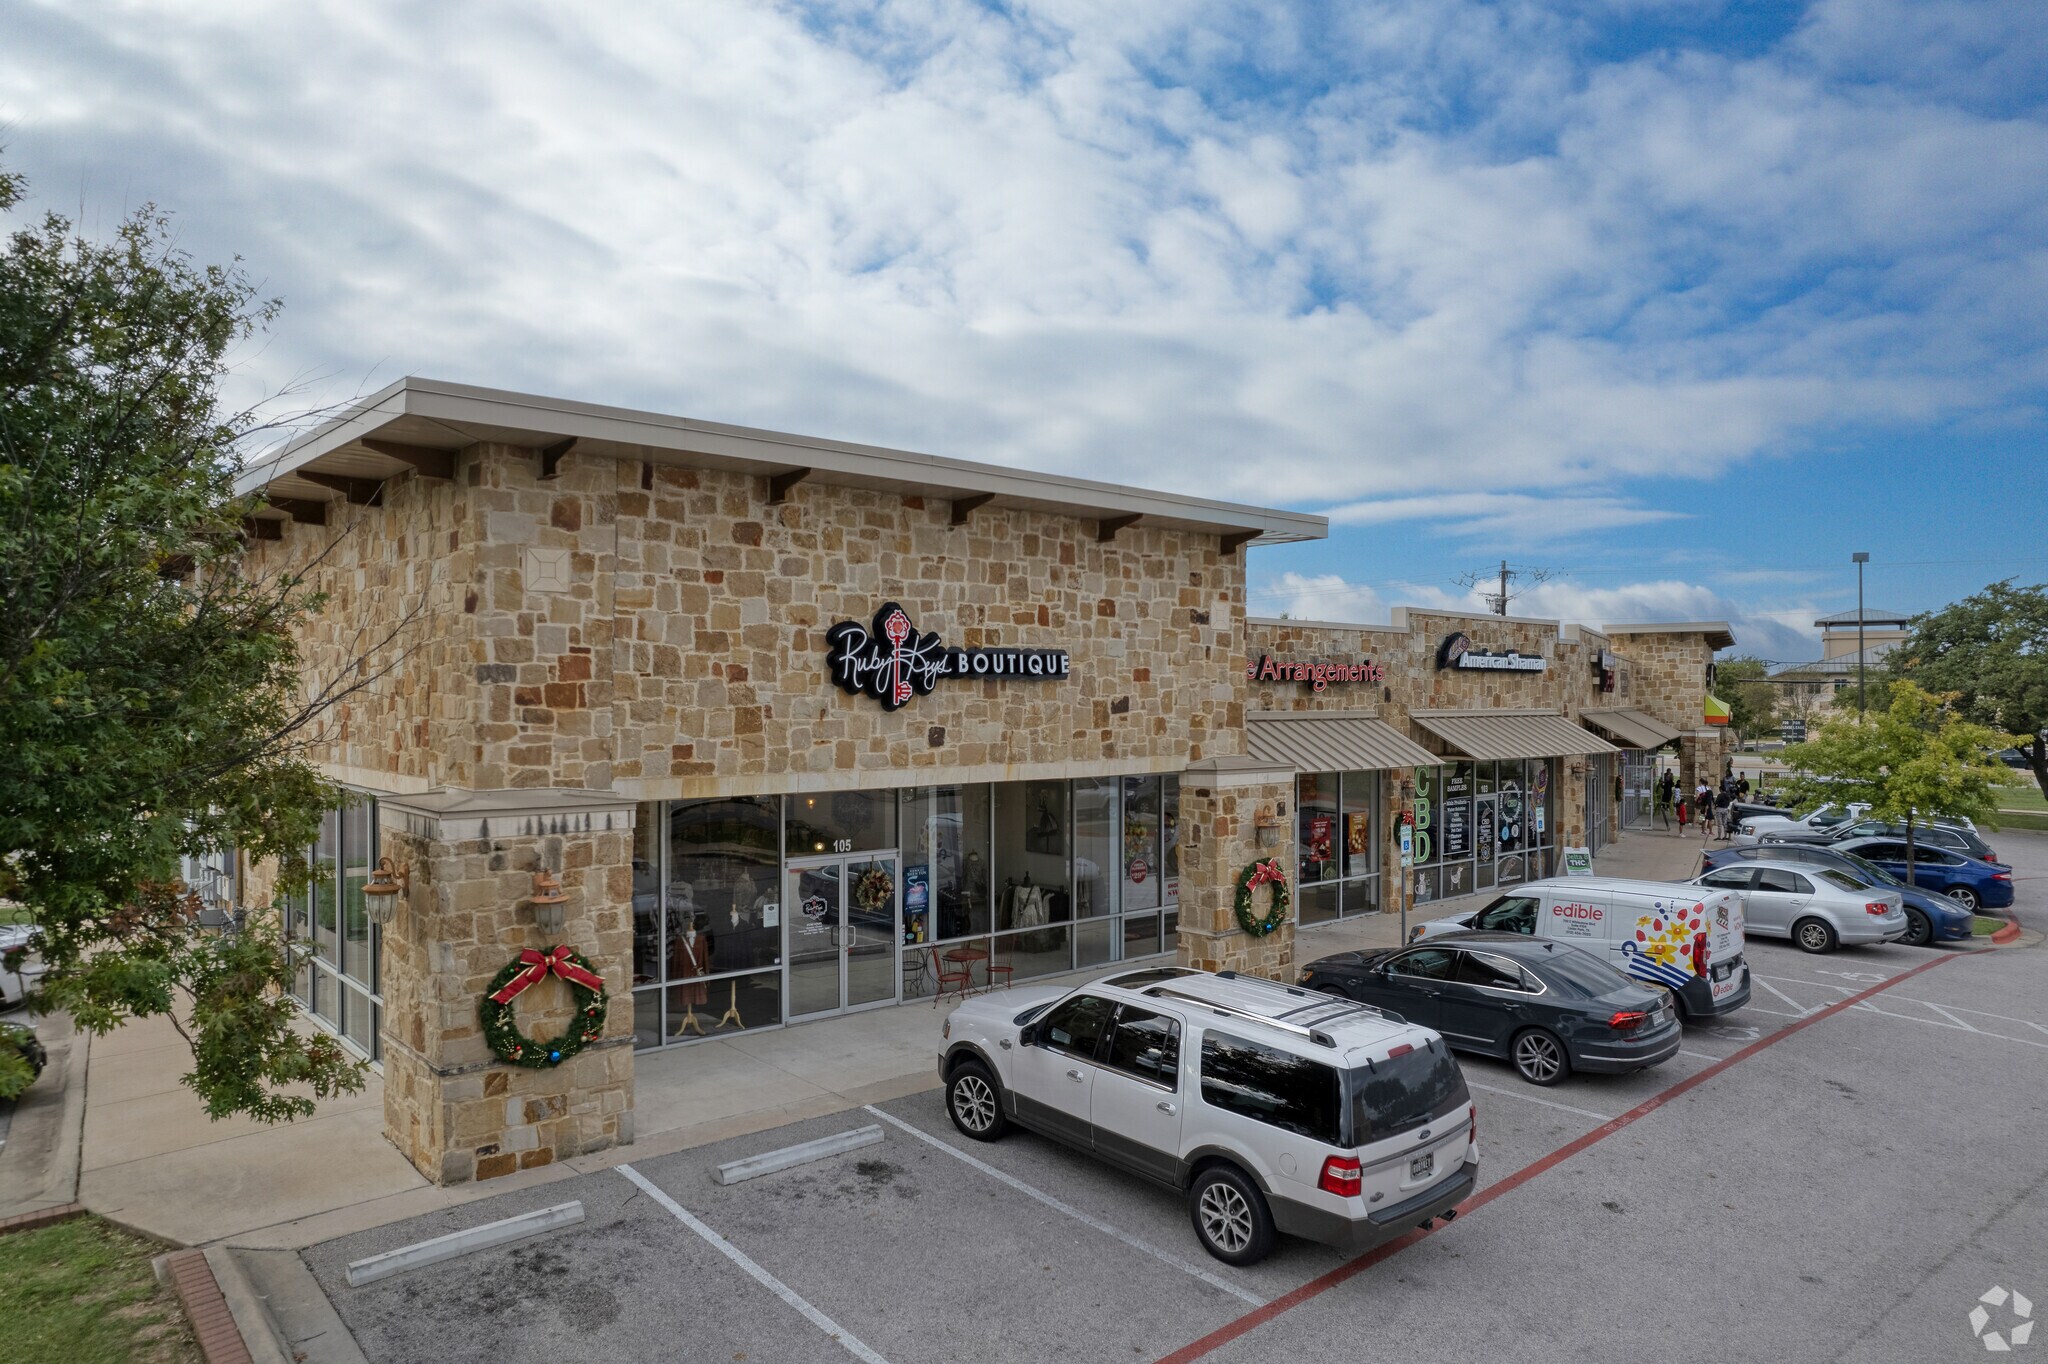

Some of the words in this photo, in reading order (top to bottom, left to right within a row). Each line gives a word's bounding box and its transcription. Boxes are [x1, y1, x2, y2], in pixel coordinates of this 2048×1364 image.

[839, 628, 894, 693] Ruby
[893, 635, 952, 690] Keys
[958, 653, 1070, 674] BOUTIQUE
[1260, 655, 1385, 692] Arrangements
[1451, 777, 1463, 785] FREE
[1447, 784, 1467, 792] SAMPLES
[1481, 785, 1489, 793] 103
[833, 838, 852, 853] 105
[1553, 903, 1603, 920] edible
[1720, 983, 1734, 995] edible
